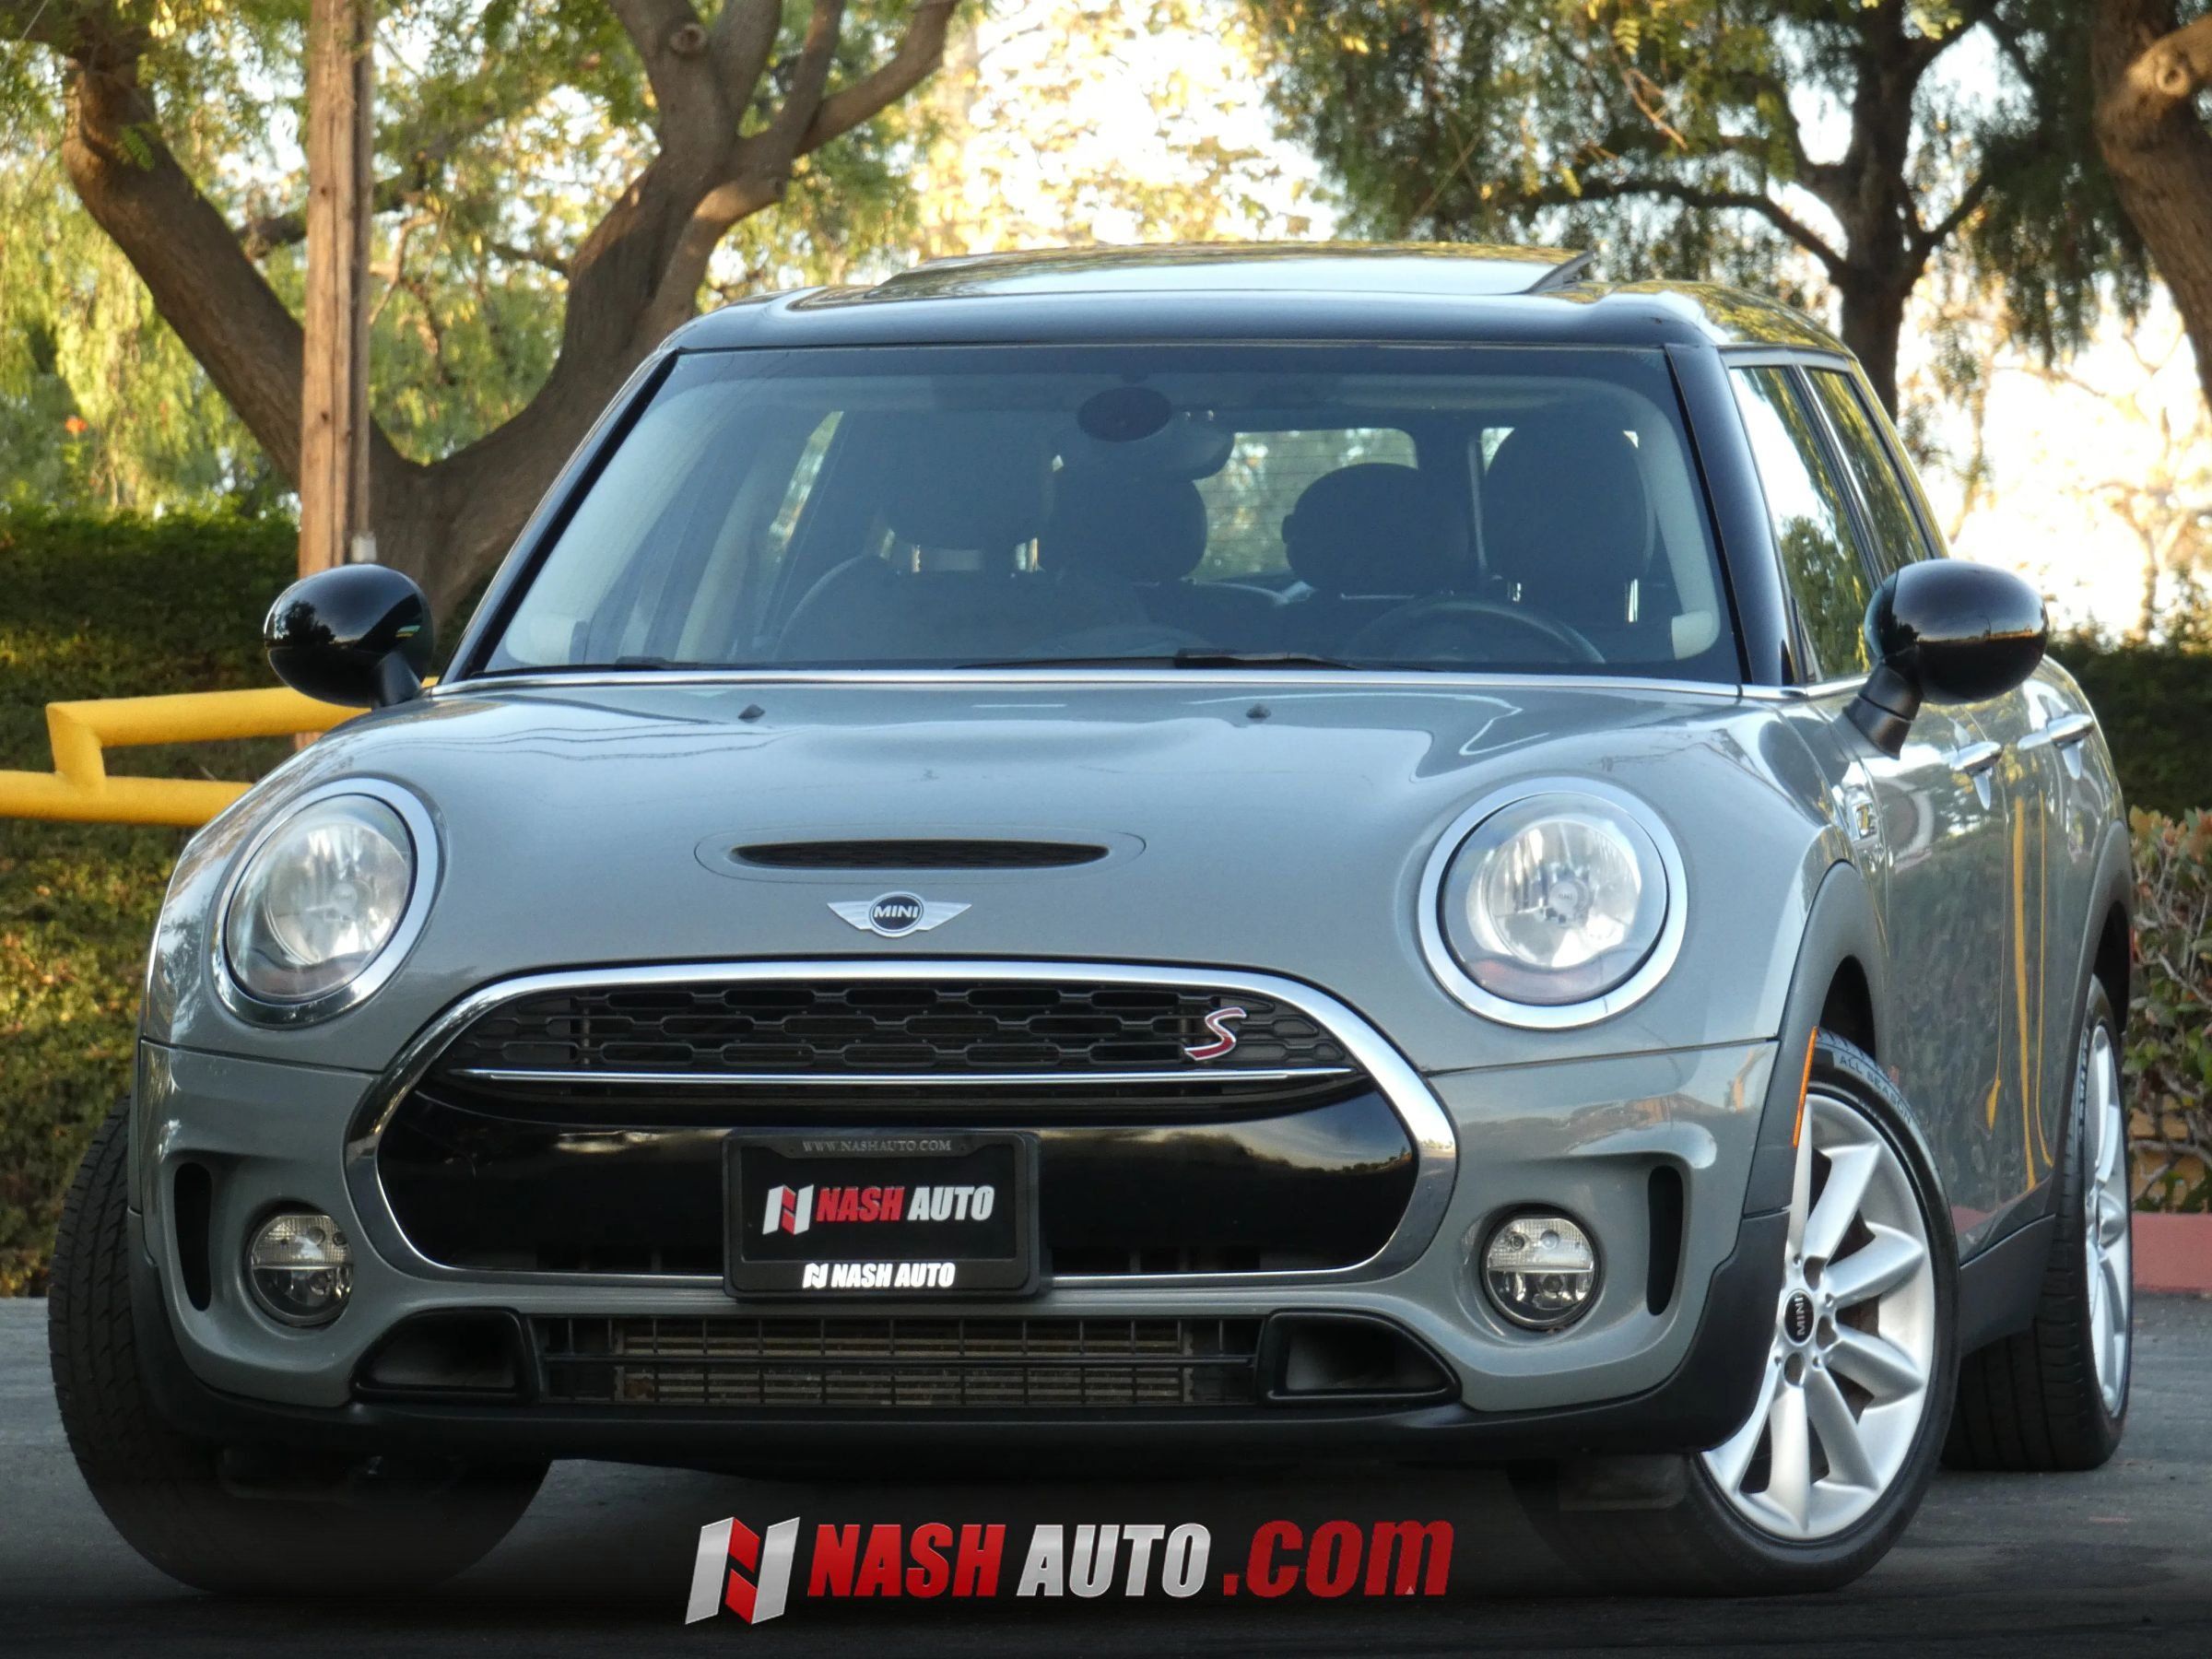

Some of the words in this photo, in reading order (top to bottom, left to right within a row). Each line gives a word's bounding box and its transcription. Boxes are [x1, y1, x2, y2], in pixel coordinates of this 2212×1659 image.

[874, 905, 919, 919] MINI
[1184, 1006, 1247, 1061] S
[802, 1139, 952, 1152] WWW.NASHAUTO.COM
[817, 1185, 905, 1222] NASH
[907, 1185, 995, 1221] AUTO
[830, 1263, 893, 1288] NASH
[894, 1263, 956, 1288] AUTO
[1794, 1297, 1806, 1336] MINI
